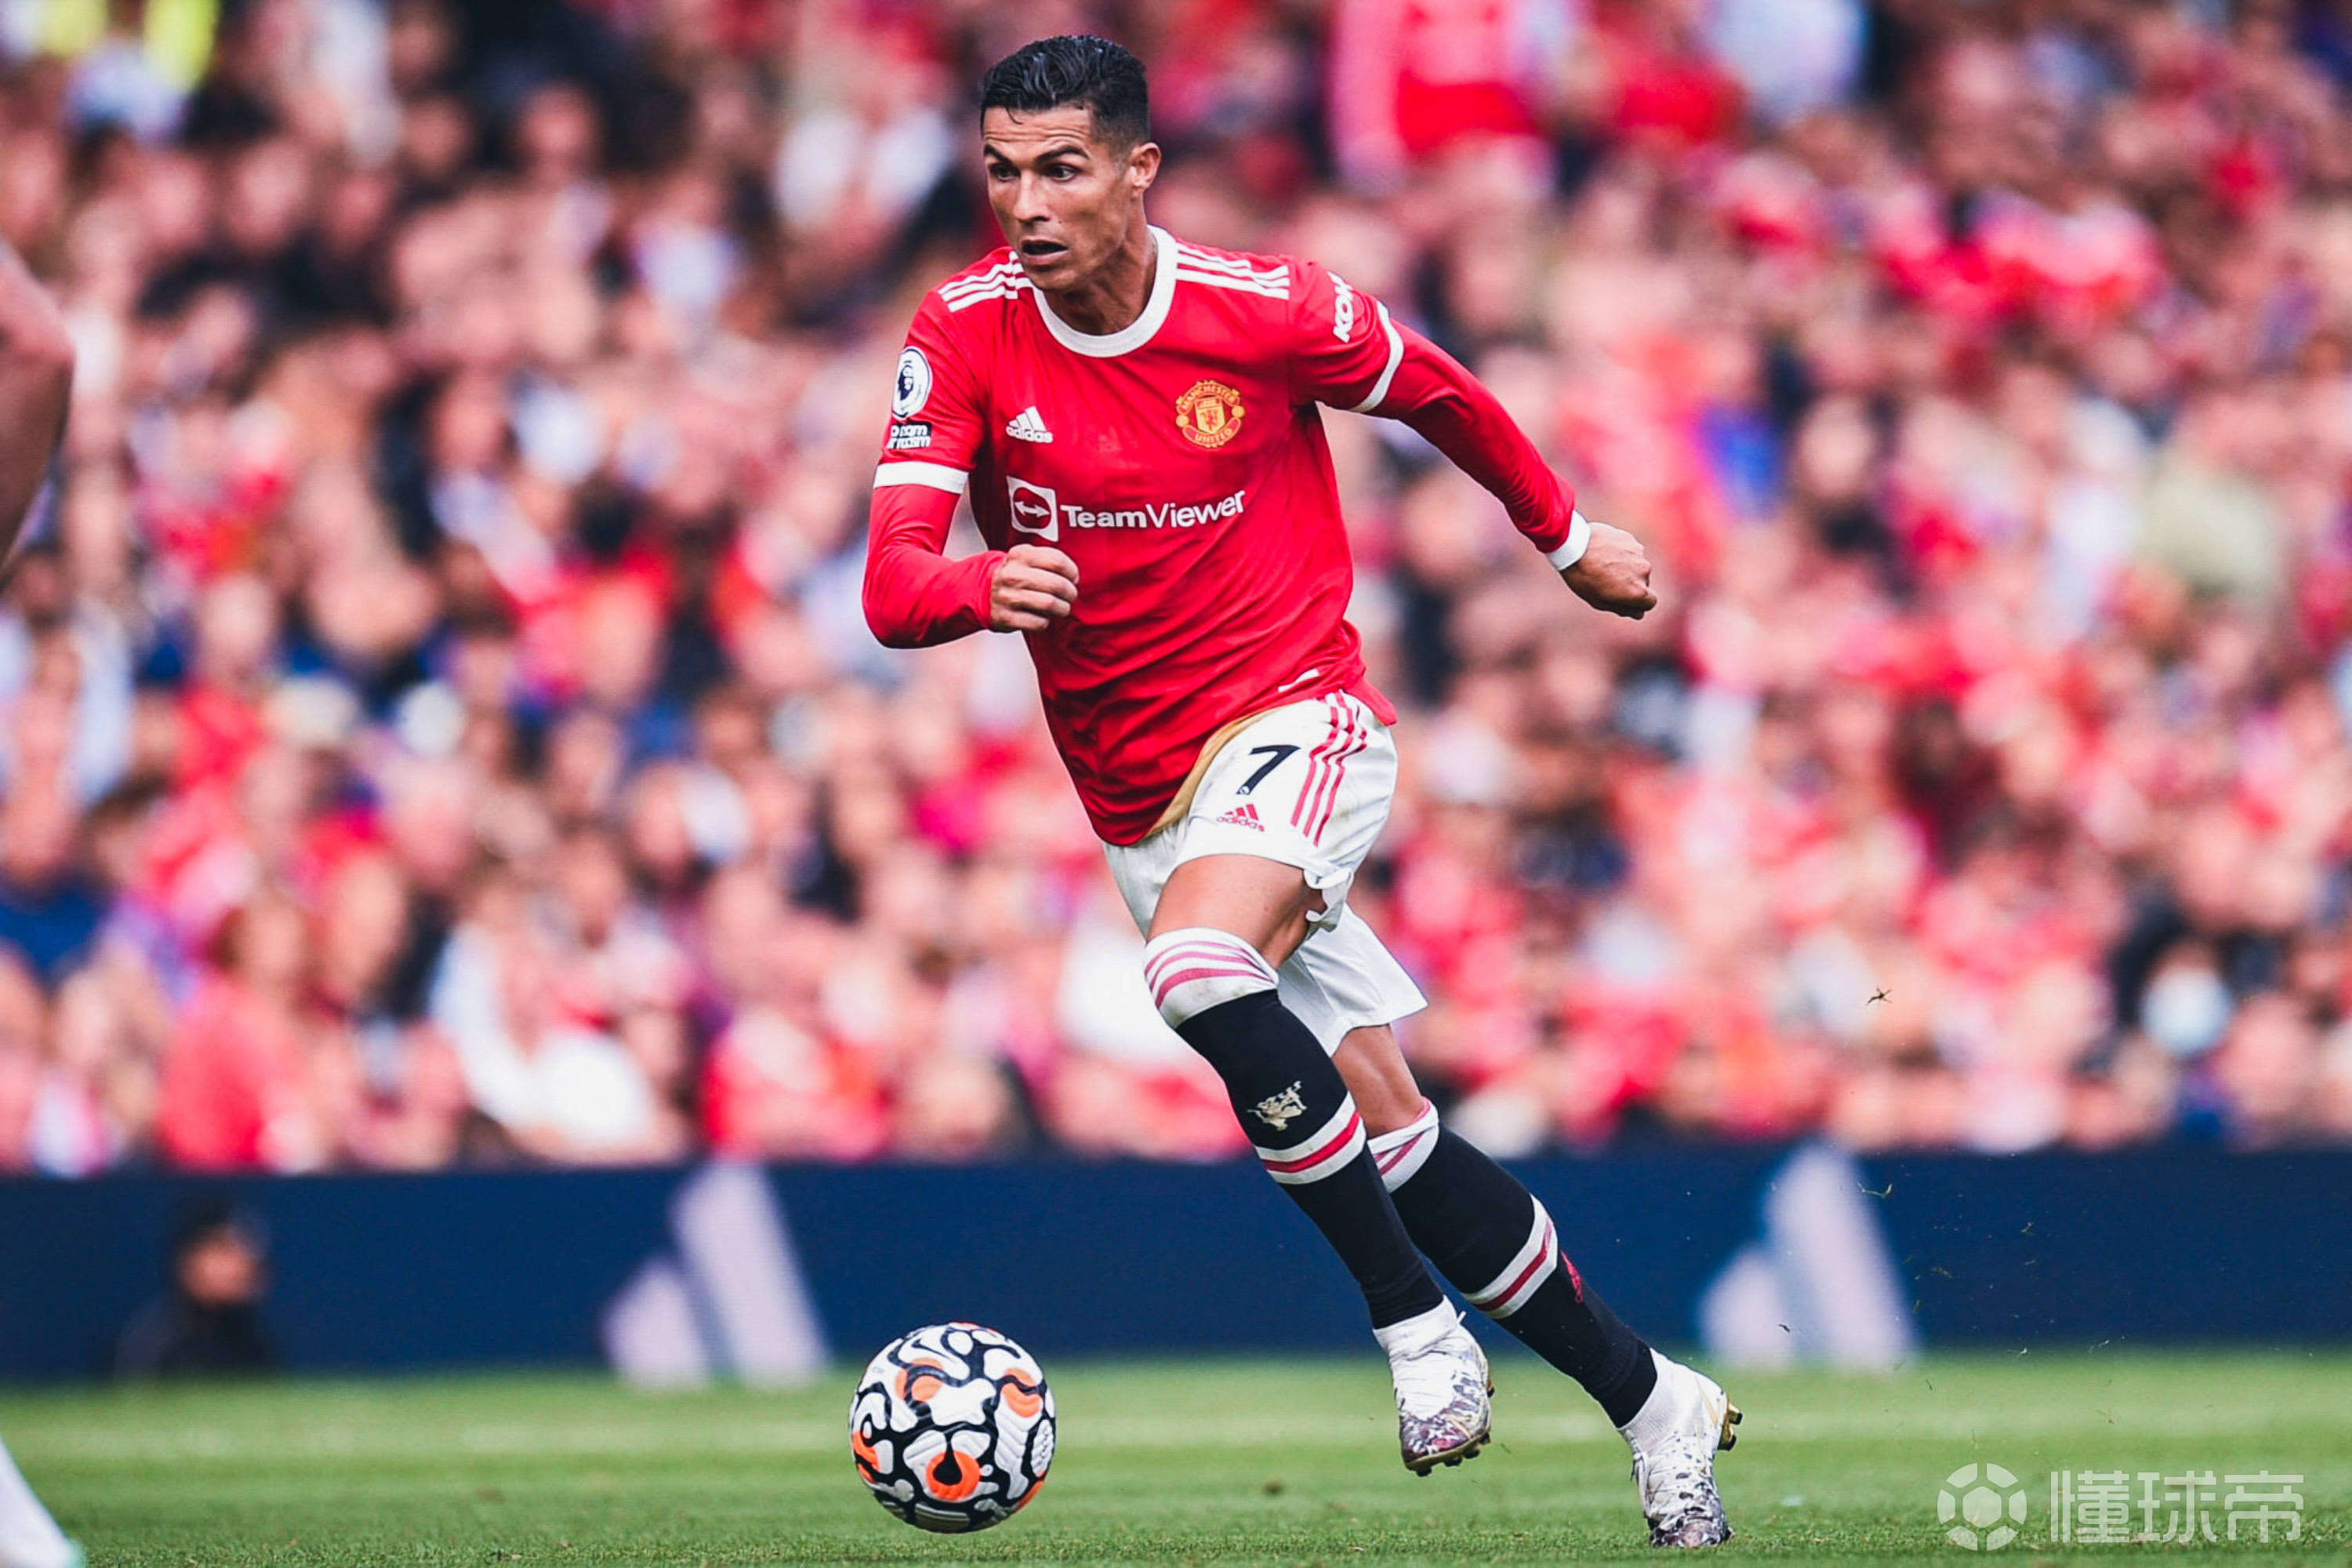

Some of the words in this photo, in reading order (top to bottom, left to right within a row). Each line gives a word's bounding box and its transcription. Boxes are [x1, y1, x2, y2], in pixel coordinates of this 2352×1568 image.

[1060, 490, 1246, 528] TeamViewer
[1236, 744, 1301, 796] 7
[1216, 816, 1265, 833] adidas
